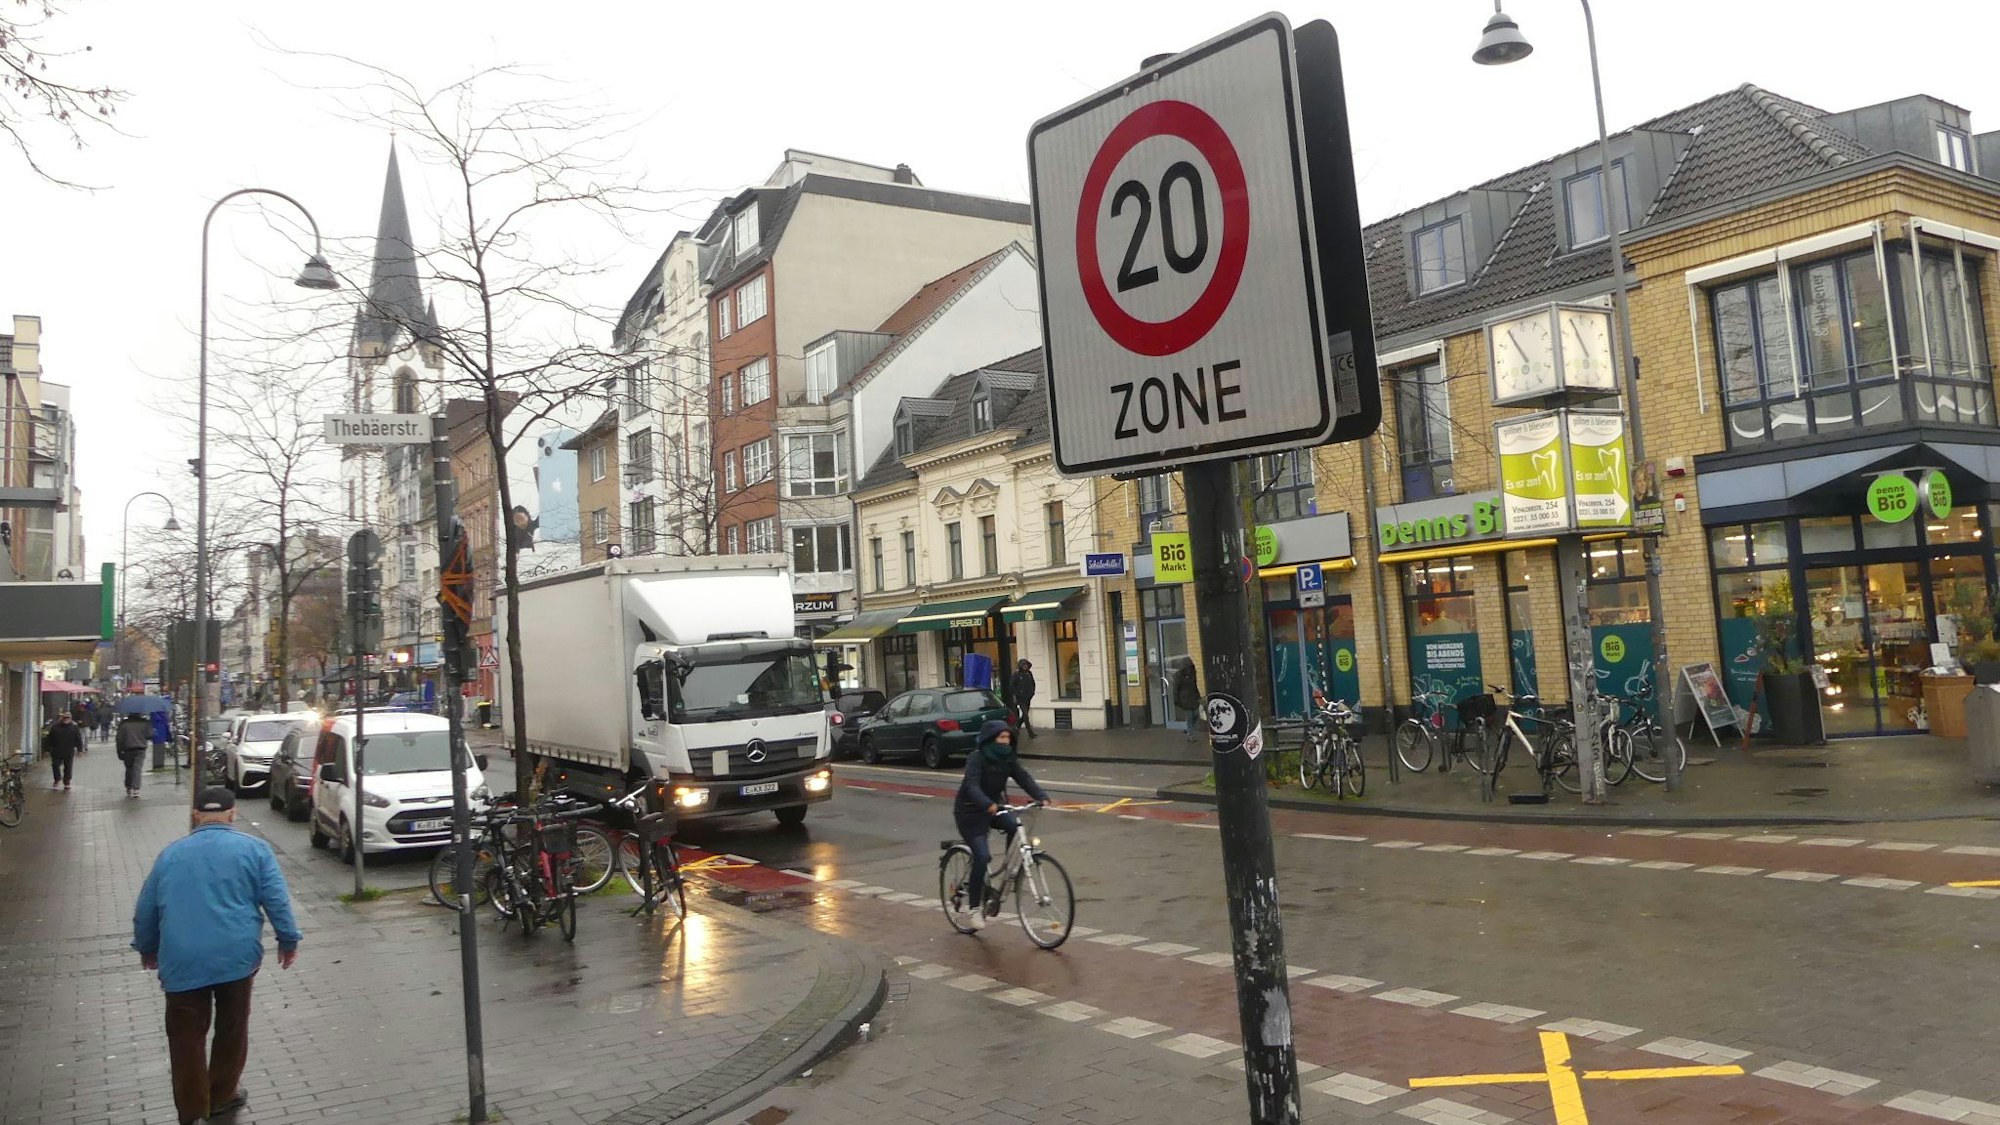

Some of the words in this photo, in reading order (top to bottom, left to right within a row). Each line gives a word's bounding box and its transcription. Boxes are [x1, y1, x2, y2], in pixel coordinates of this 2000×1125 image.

[1110, 160, 1209, 293] 20
[1110, 359, 1247, 441] ZONE
[331, 418, 423, 437] Thebäerstr.
[1545, 500, 1558, 510] 254
[1605, 498, 1615, 507] 254
[1161, 562, 1187, 572] Markt
[1300, 568, 1315, 590] P
[795, 600, 834, 611] RZUM
[1438, 649, 1465, 658] ABENDS
